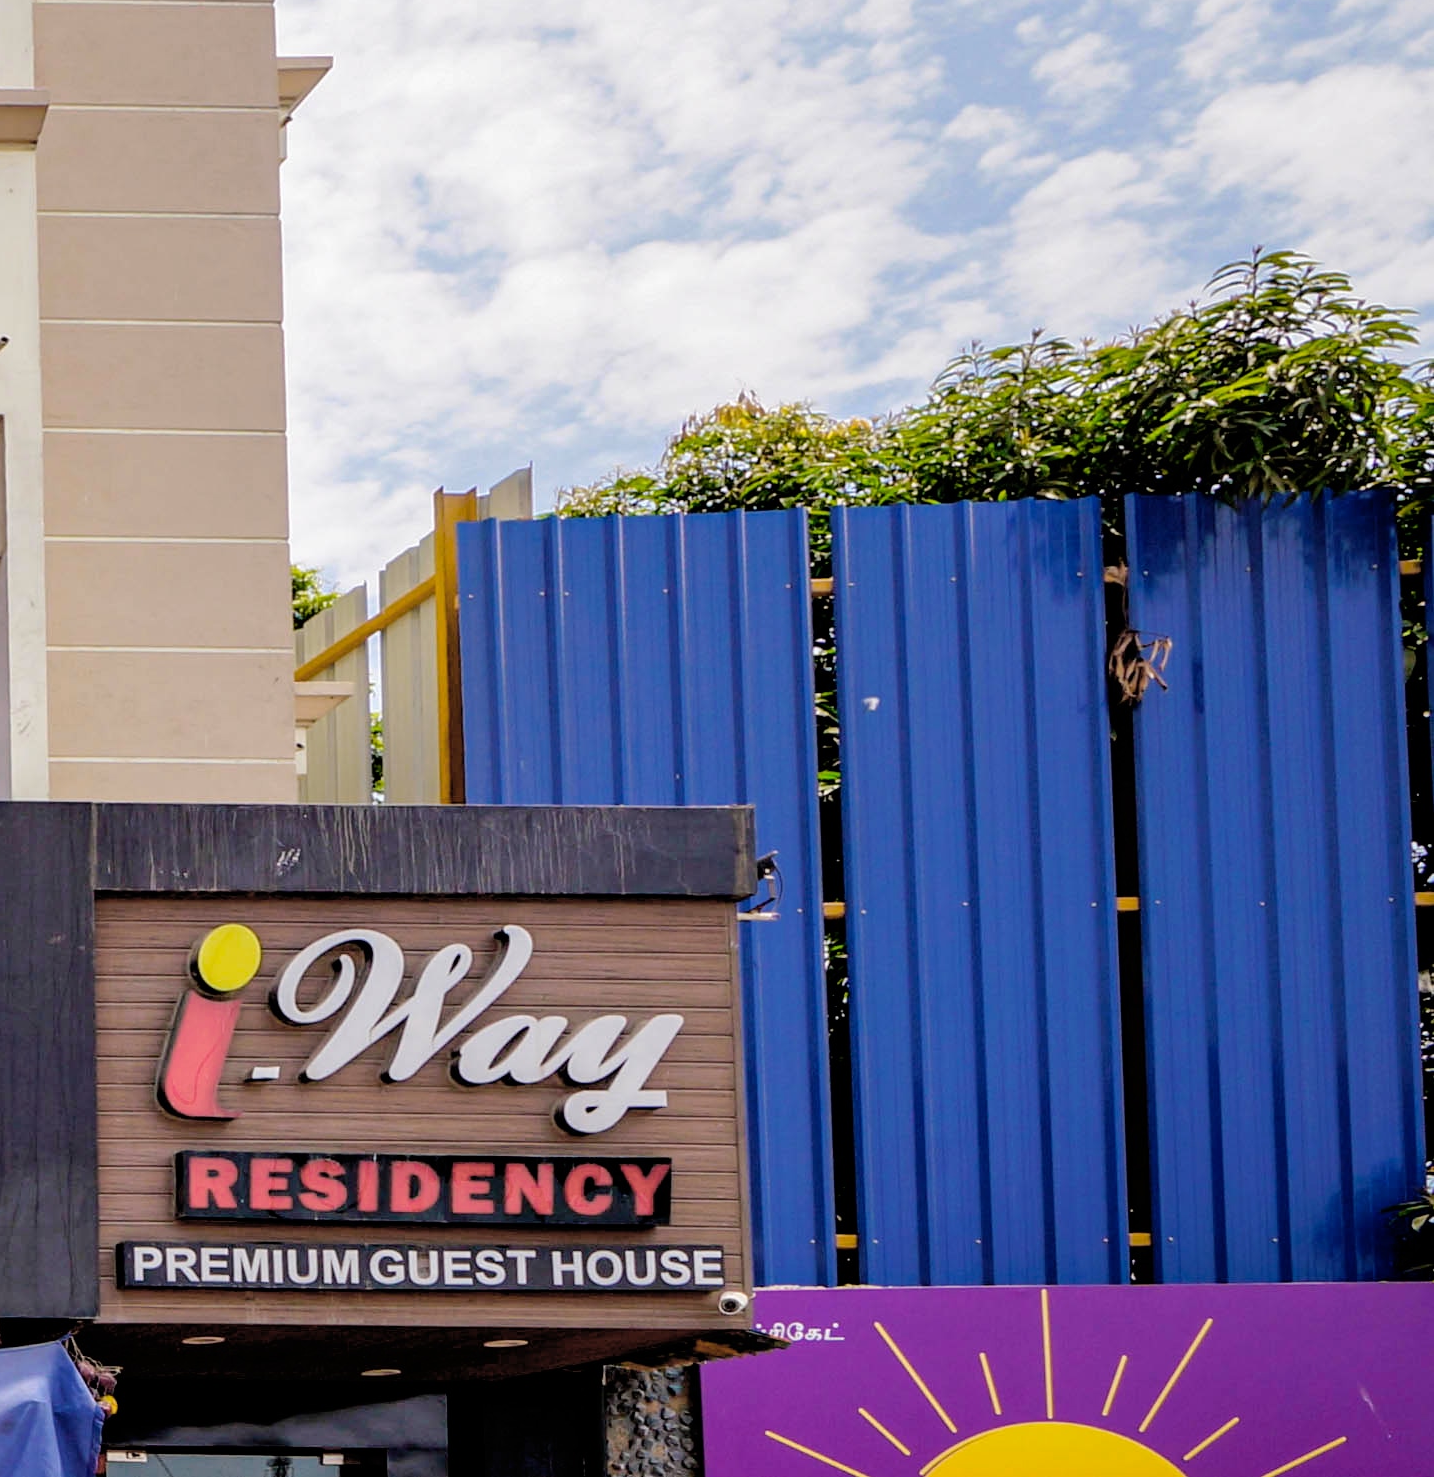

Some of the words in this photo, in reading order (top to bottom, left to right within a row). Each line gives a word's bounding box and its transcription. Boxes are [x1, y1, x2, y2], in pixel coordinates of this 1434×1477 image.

[187, 1155, 672, 1217] RESIDENCY
[132, 1245, 360, 1285] PREMIUM
[369, 1248, 536, 1286] GUEST
[550, 1250, 724, 1287] HOUSE
